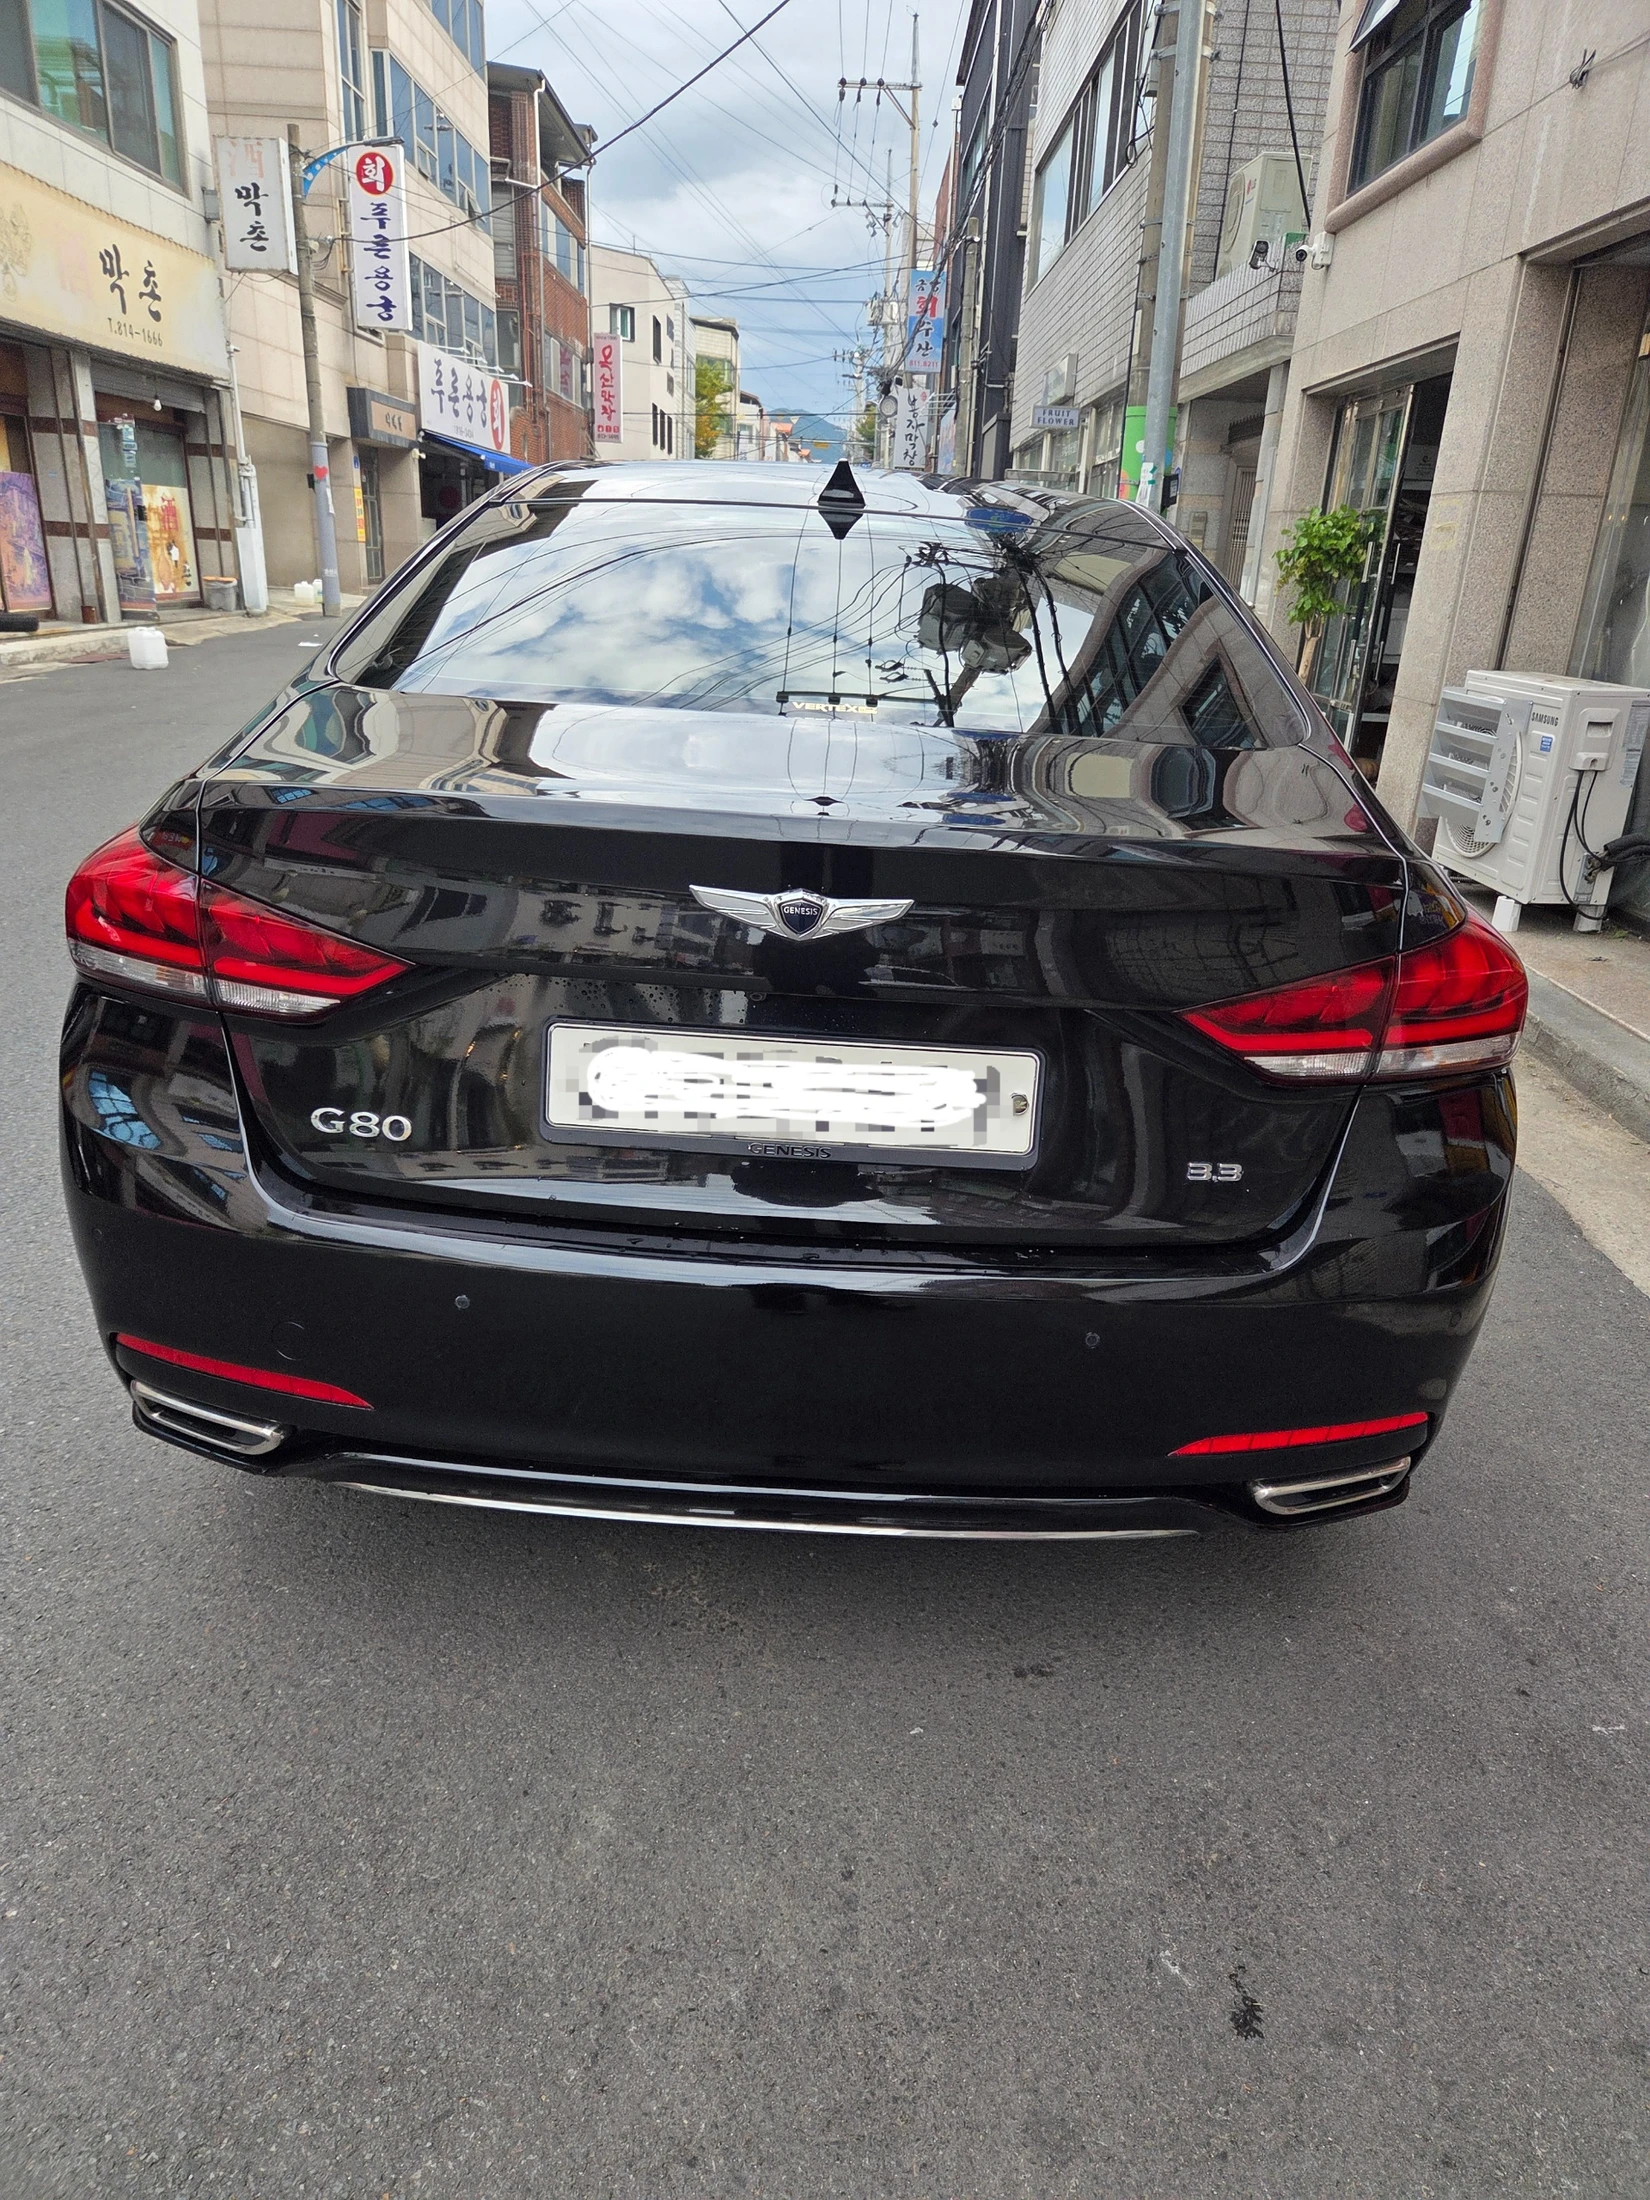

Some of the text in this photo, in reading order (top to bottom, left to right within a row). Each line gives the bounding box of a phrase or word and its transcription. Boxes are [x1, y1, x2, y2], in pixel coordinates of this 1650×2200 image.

[361, 155, 385, 193] 회
[234, 182, 270, 252] 막촌
[98, 243, 162, 323] 막촌
[107, 317, 163, 347] T.814-1666
[1037, 417, 1075, 426] FLOWER
[1042, 410, 1072, 418] FRUIT
[1531, 711, 1559, 727] SAMSUNG
[783, 905, 819, 916] GENESIS
[310, 1107, 412, 1142] G80
[747, 1142, 832, 1159] GENESIS
[1187, 1162, 1242, 1182] 3.3
